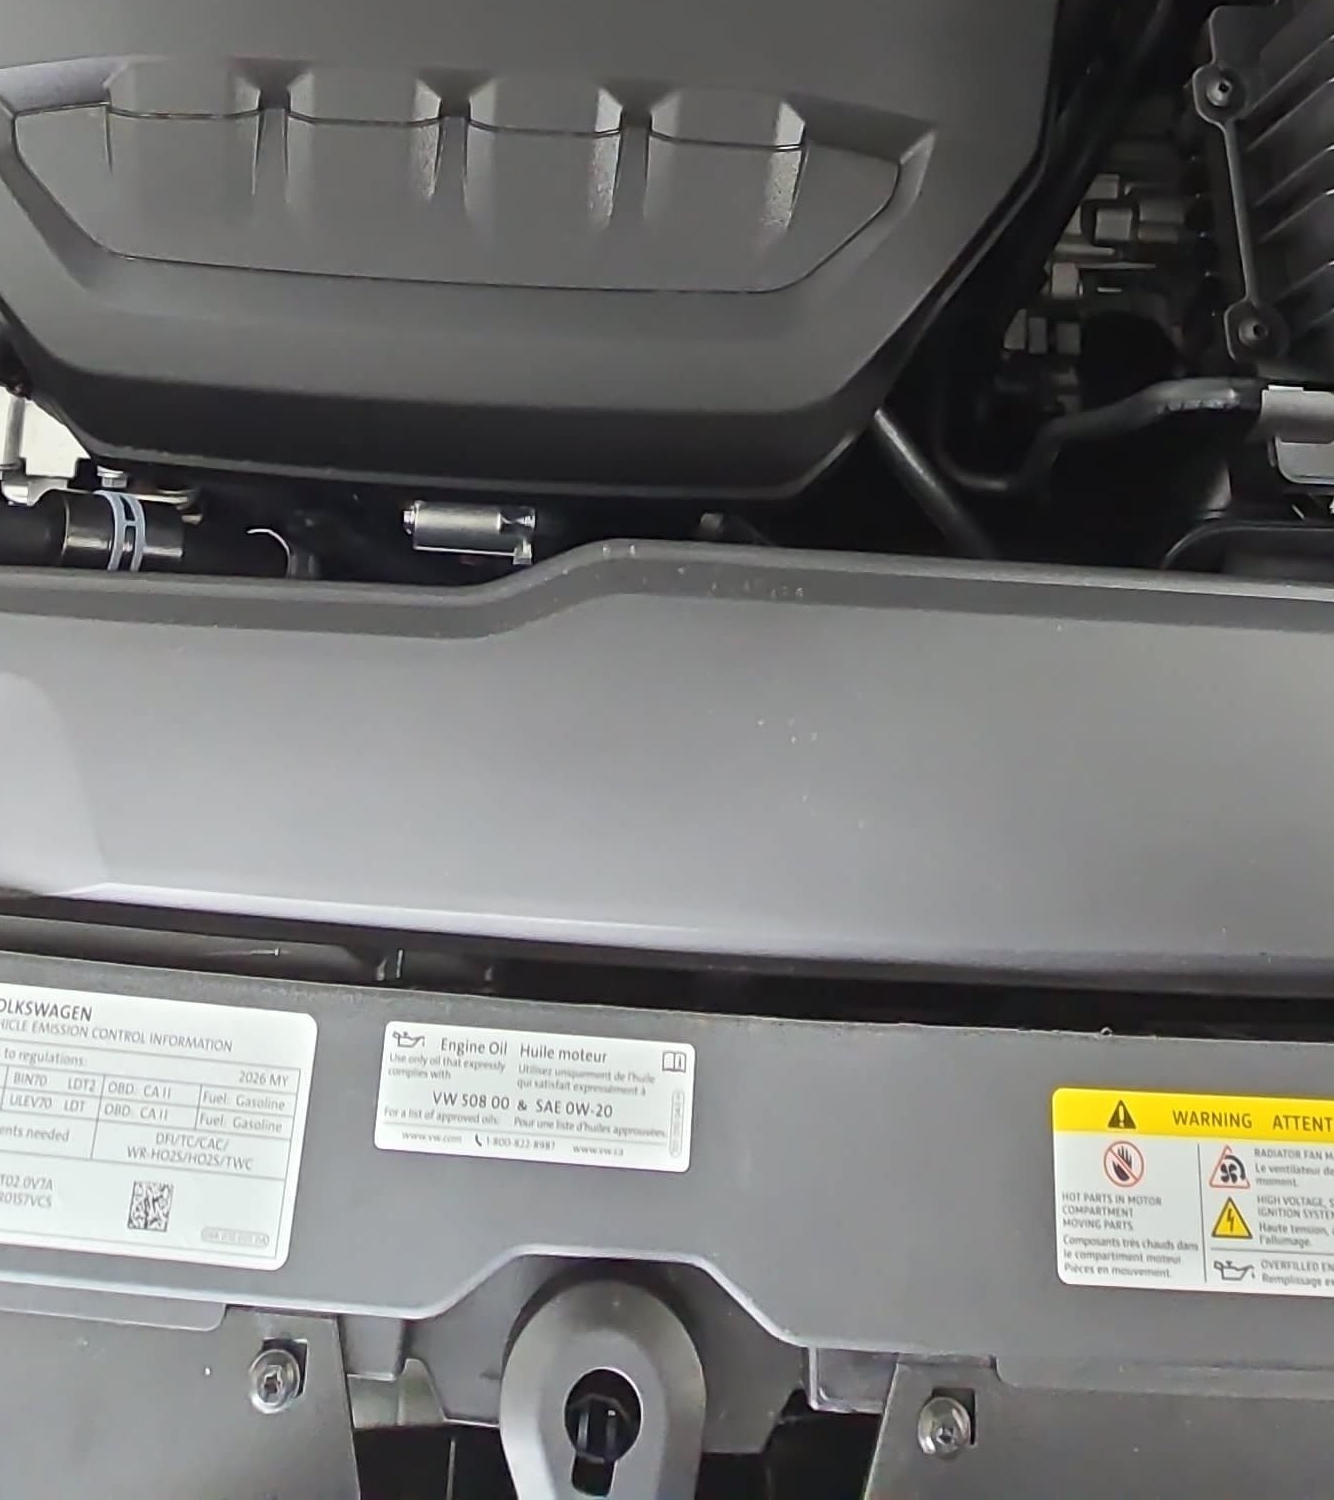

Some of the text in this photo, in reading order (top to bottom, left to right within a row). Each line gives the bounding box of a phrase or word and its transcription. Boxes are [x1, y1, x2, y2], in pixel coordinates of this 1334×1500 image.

[32, 1020, 88, 1038] EMISSION
[91, 1026, 146, 1043] CONTROL
[149, 1032, 233, 1052] INFORMATION
[3, 1045, 16, 1059] to
[440, 1037, 507, 1057] Engine Oil
[520, 1044, 606, 1063] Huile moteur
[389, 1052, 406, 1062] Use
[443, 1057, 461, 1066] that
[238, 1070, 288, 1086] 2026 MY
[430, 1069, 451, 1079] with
[12, 1071, 48, 1086] BIN70
[142, 1084, 160, 1097] CA
[235, 1094, 285, 1110] Gasoline
[432, 1091, 612, 1117] VW 508 00 & SAE 0W-20
[8, 1093, 52, 1109] ULEV70
[139, 1106, 157, 1119] CA
[232, 1115, 282, 1132] Gasoline
[383, 1107, 398, 1116] For
[1172, 1109, 1252, 1129] WARNING
[26, 1125, 69, 1141] needed
[1254, 1147, 1301, 1158] RADIATOR
[1303, 1150, 1322, 1159] FAN
[1061, 1192, 1162, 1206] HOT PARTS IN MOTOR
[1257, 1195, 1280, 1205] HIGH
[1062, 1204, 1133, 1217] COMPARTMENT
[1257, 1206, 1300, 1218] IGNITION
[1062, 1217, 1133, 1230] MOVING PARTS
[1261, 1259, 1318, 1271] OVERFILLED
